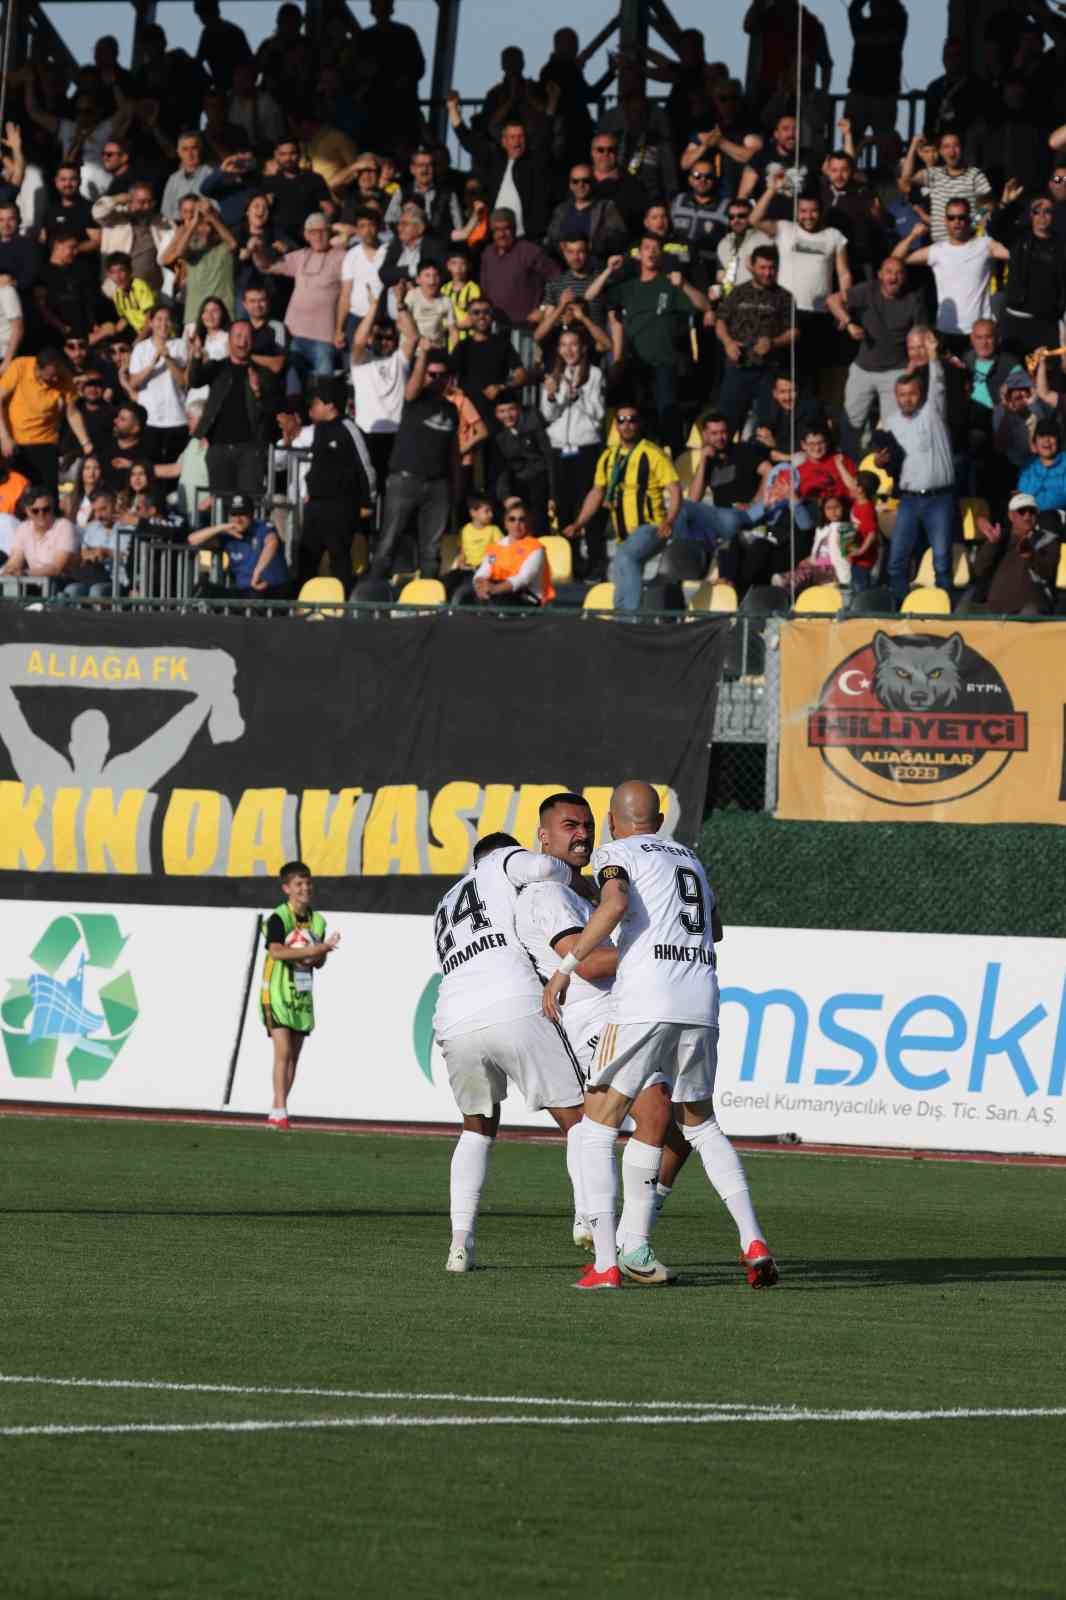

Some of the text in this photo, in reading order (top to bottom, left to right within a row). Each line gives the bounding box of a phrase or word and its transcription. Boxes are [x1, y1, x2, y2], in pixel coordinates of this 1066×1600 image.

[151, 655, 190, 682] FK
[896, 766, 937, 778] 2025
[674, 864, 706, 936] 9
[433, 877, 493, 964] 24
[654, 944, 698, 962] AHMET
[720, 1091, 770, 1110] Genel
[775, 1093, 887, 1117] Kumanyacılık
[892, 1103, 912, 1116] ve
[952, 1101, 980, 1119] Tic.
